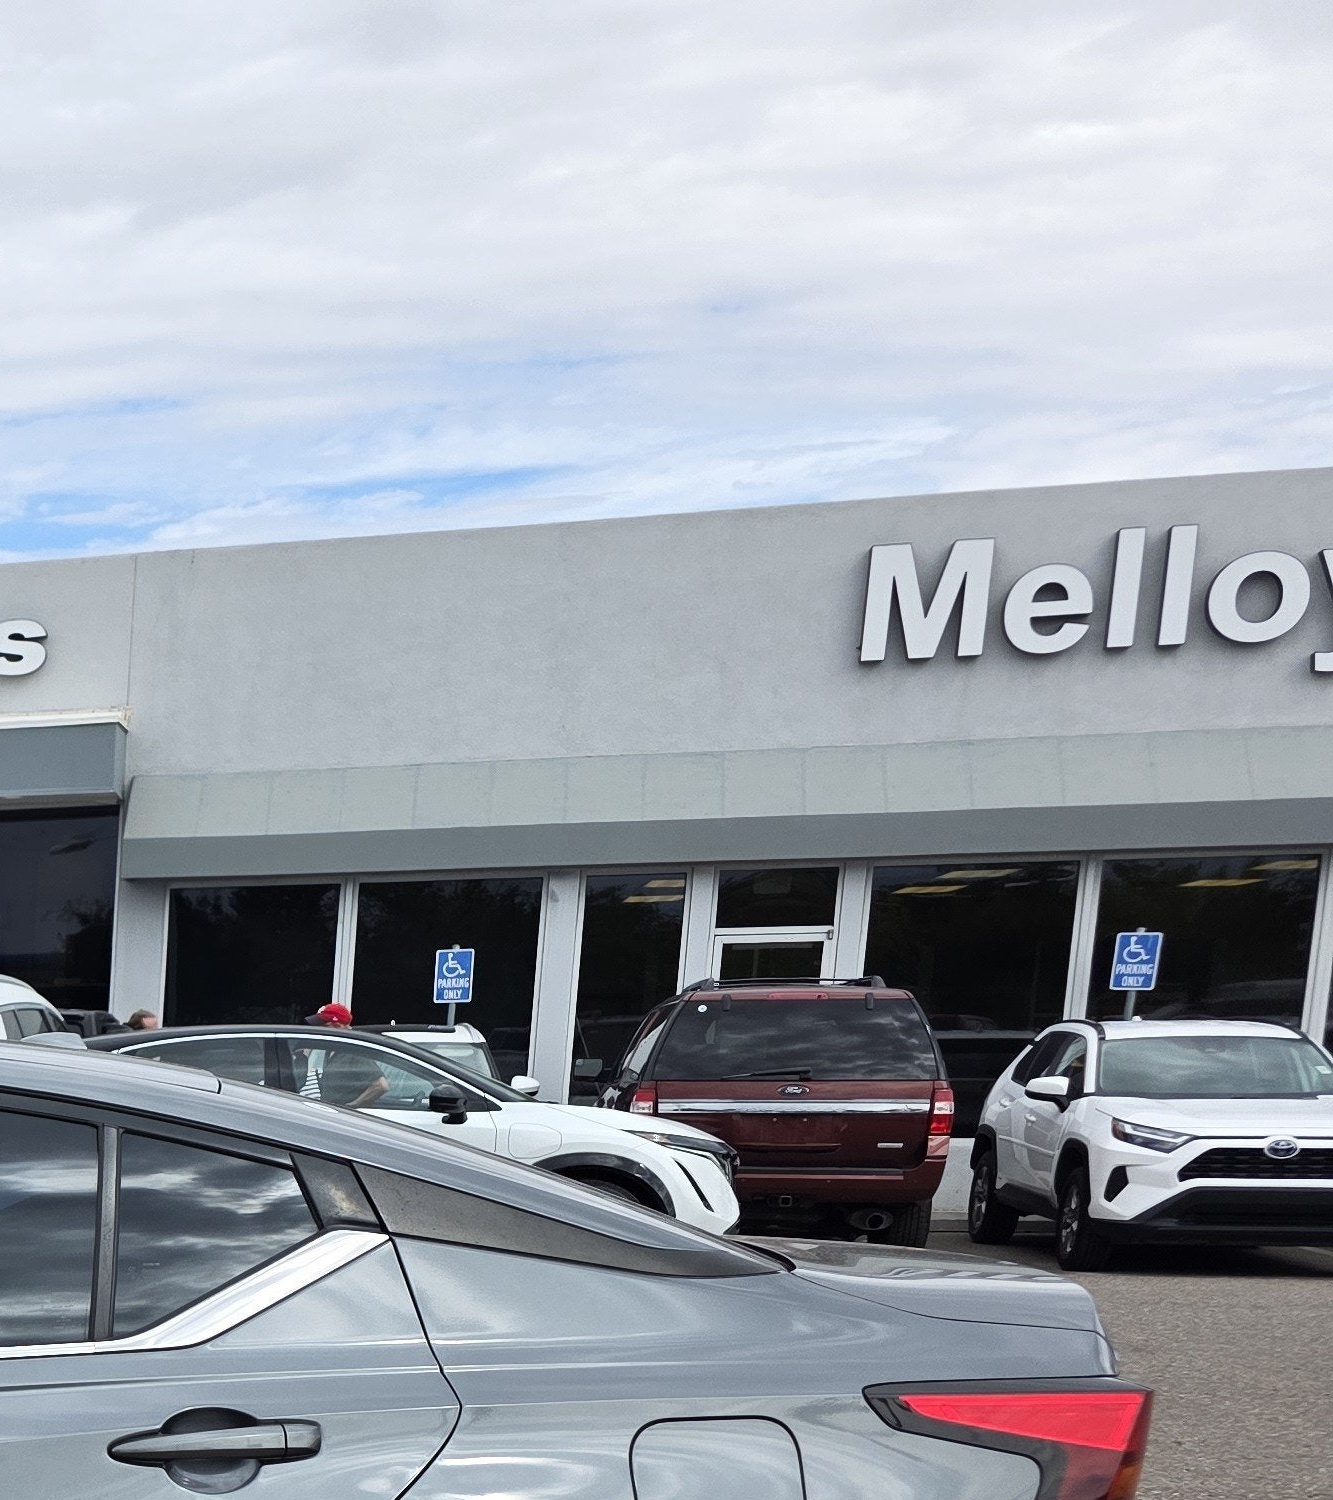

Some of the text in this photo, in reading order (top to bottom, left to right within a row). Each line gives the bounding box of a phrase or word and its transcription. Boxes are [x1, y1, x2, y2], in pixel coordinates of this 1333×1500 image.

[860, 524, 1333, 672] Mello
[1116, 964, 1154, 975] PARKING
[437, 978, 470, 988] PARKING
[1121, 976, 1145, 987] ONLY
[443, 989, 462, 1000] ONLY
